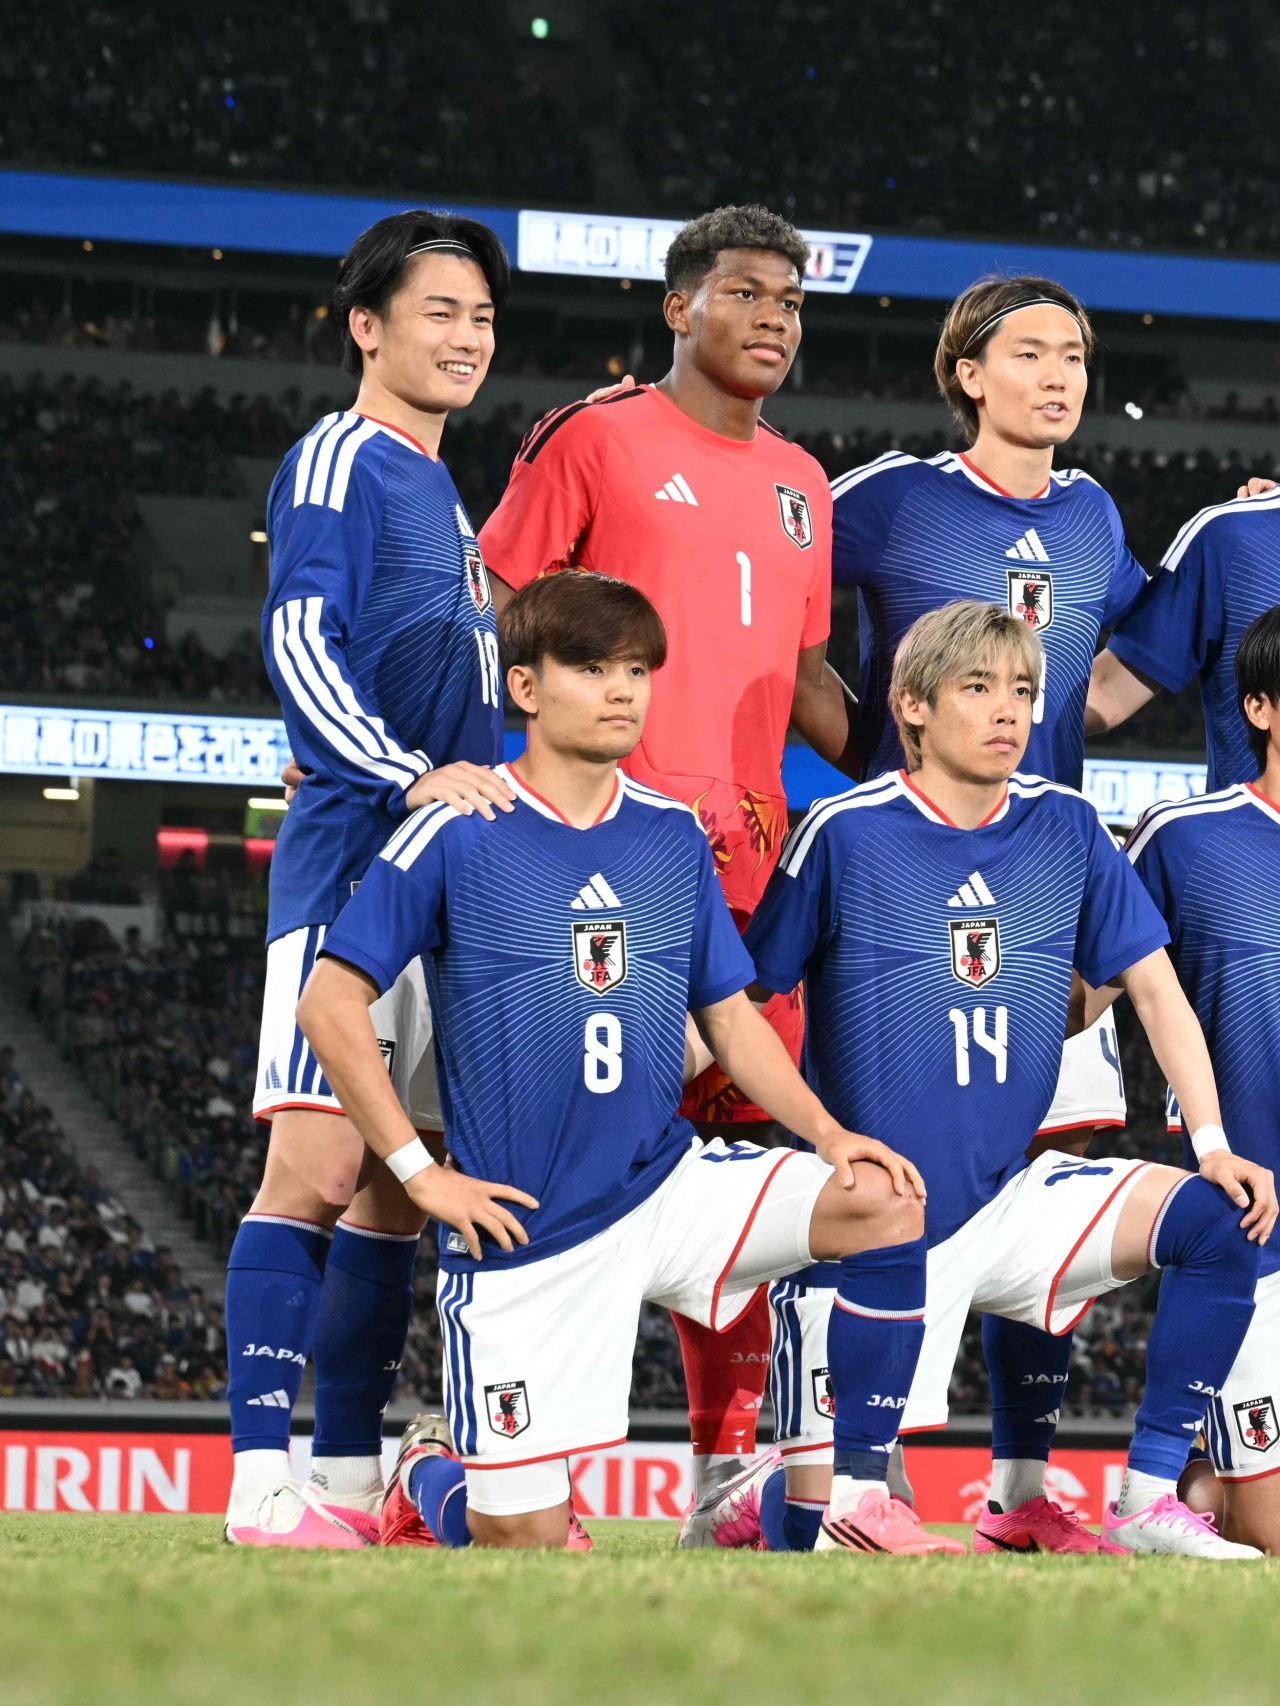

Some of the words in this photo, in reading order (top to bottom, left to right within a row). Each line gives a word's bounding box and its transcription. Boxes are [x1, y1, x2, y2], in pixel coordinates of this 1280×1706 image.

[1017, 572, 1041, 580] JAPAN
[736, 550, 752, 626] 1
[584, 923, 613, 932] JAPAN
[960, 921, 986, 929] JAPAN
[589, 970, 612, 983] JFA
[965, 966, 987, 977] JFA
[949, 1005, 1008, 1086] 14
[583, 1012, 623, 1094] 8
[242, 1343, 307, 1369] JAPA
[729, 1352, 770, 1364] JAP
[1020, 1372, 1069, 1385] JAP
[492, 1382, 517, 1391] JAPAN
[866, 1394, 906, 1410] JAP
[1242, 1399, 1264, 1409] JAPAN
[1252, 1434, 1271, 1445] JFA
[4, 1445, 191, 1512] IRIN
[570, 1457, 684, 1518] KIR
